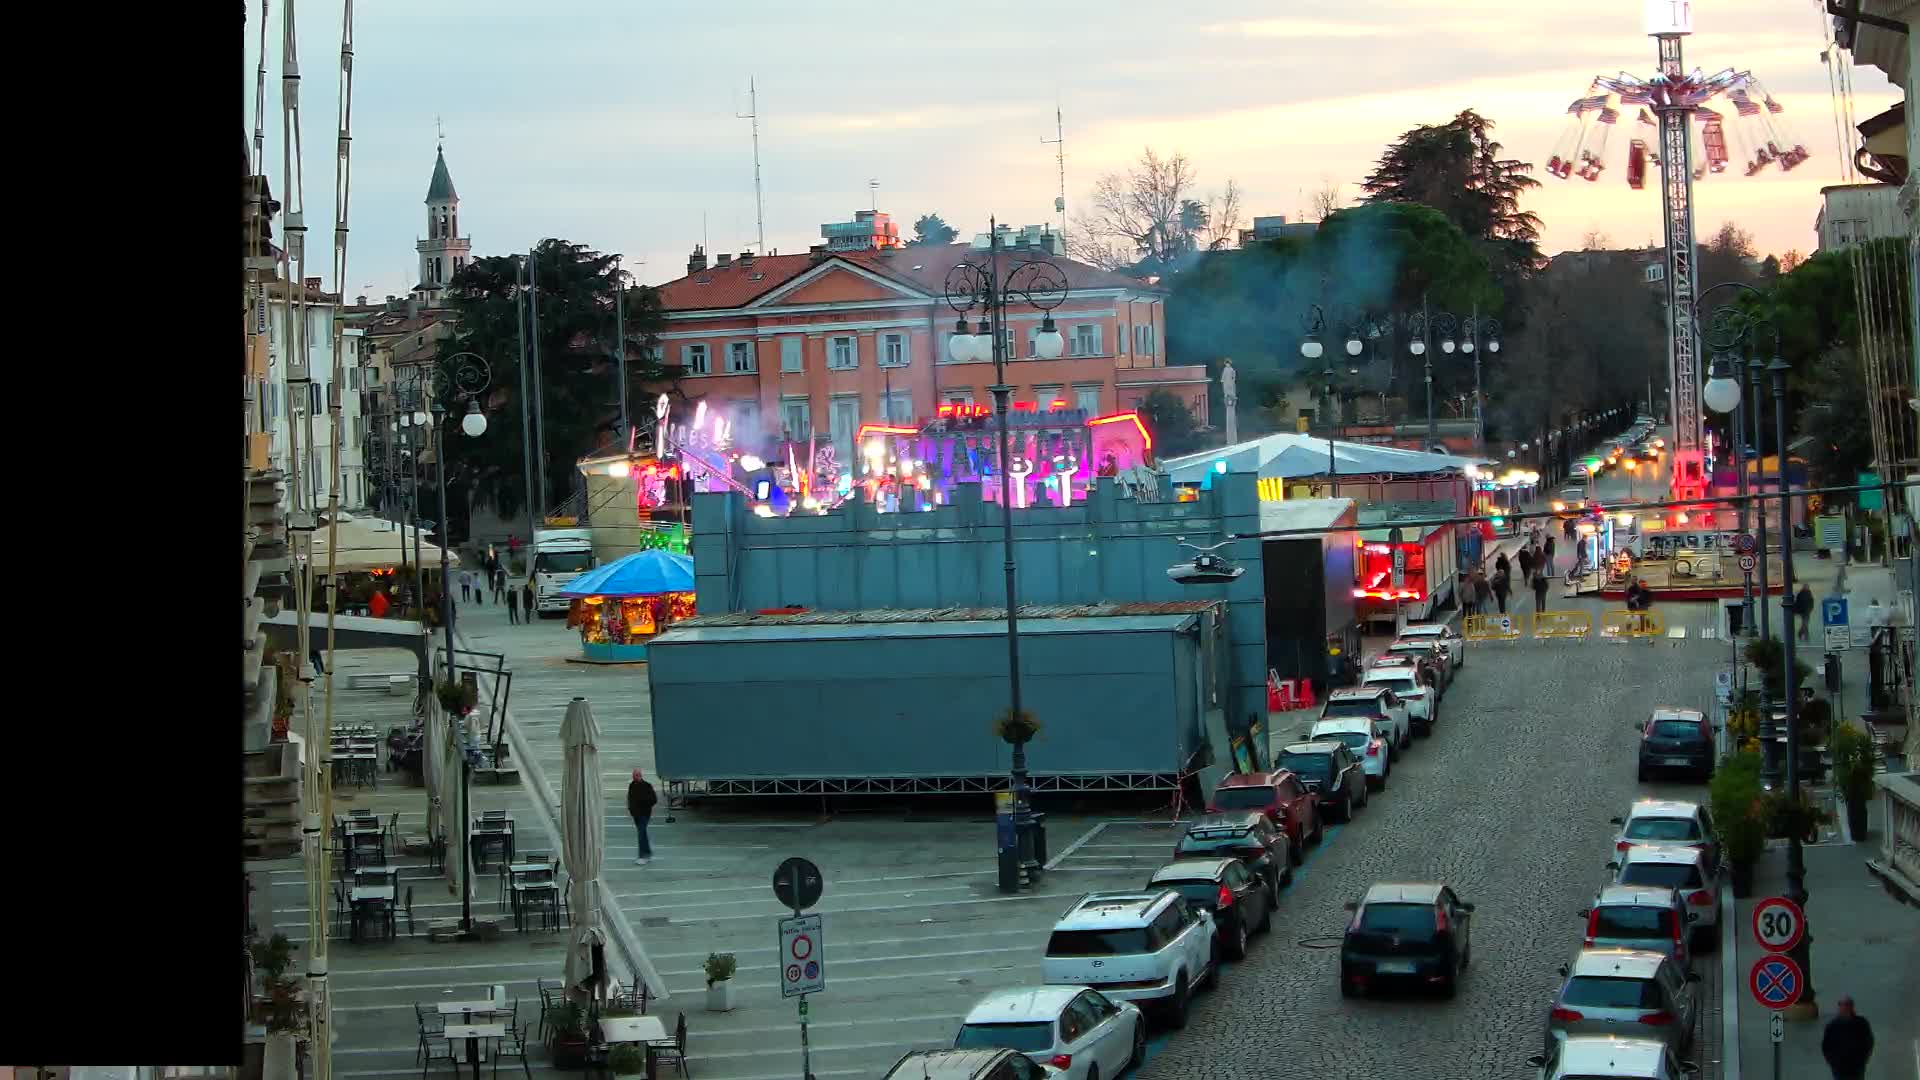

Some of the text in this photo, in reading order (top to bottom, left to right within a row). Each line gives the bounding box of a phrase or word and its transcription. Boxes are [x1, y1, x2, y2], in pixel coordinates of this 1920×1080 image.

[1743, 558, 1752, 567] 20
[1828, 603, 1842, 621] P
[1761, 912, 1792, 938] 30
